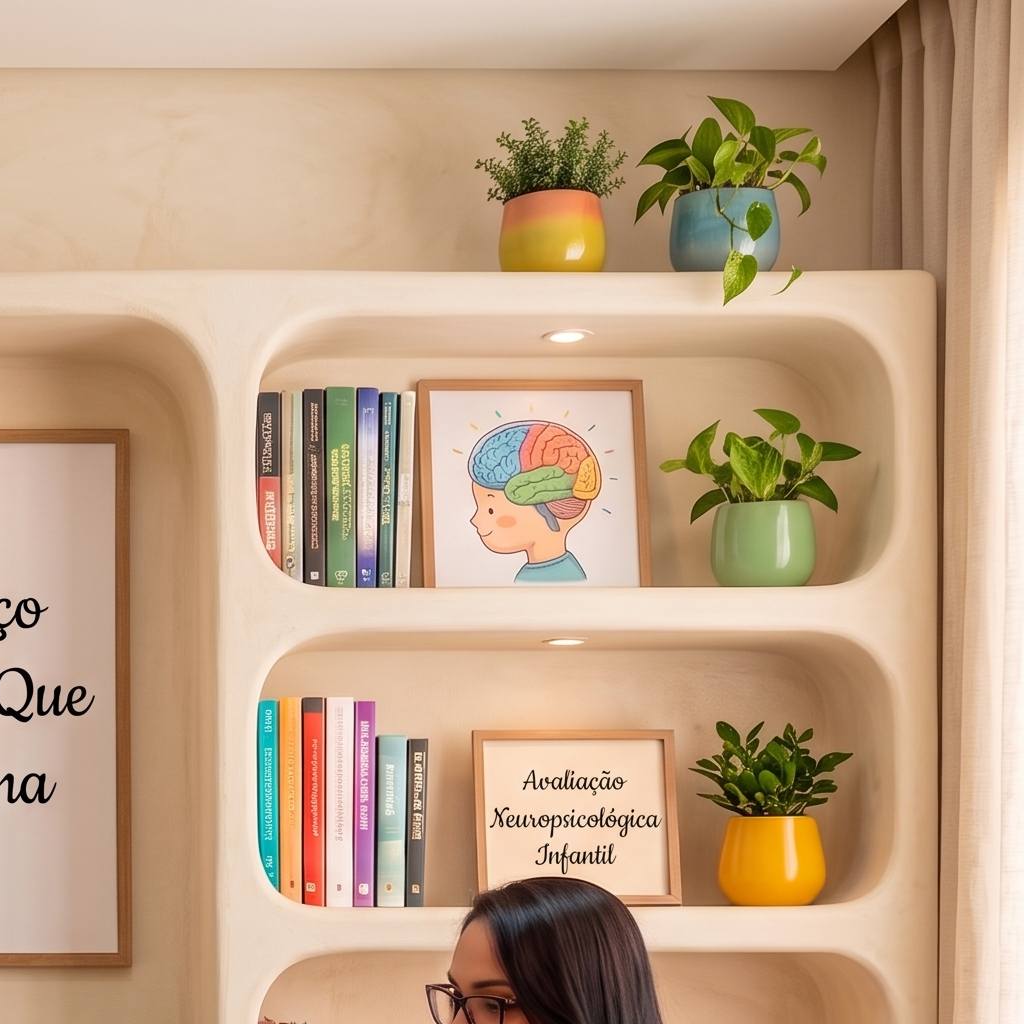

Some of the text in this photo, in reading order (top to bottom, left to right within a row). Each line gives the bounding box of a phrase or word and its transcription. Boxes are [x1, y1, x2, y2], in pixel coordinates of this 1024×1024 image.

[523, 770, 627, 795] Avaliação
[490, 806, 662, 838] Neuropsicológica
[535, 843, 616, 874] Infantil
